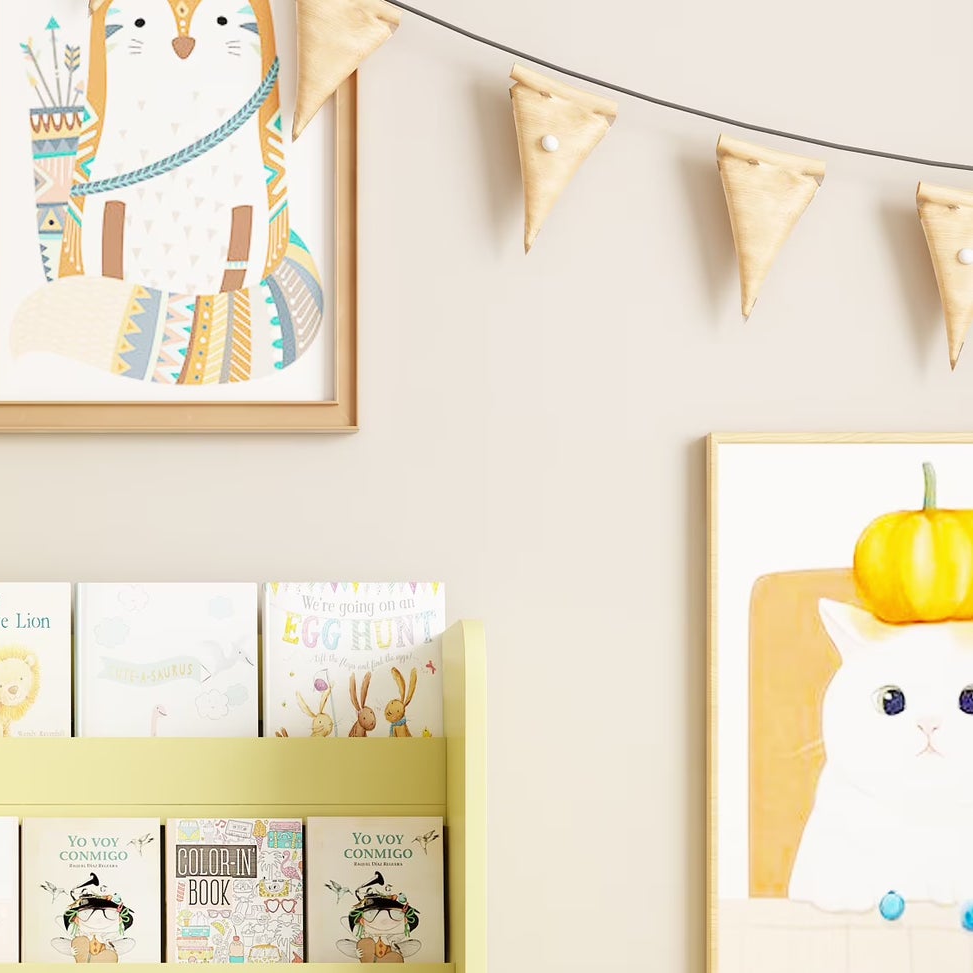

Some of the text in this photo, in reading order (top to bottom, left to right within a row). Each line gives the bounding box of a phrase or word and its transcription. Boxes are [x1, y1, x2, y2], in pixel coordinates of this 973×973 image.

[302, 594, 415, 617] We're going on an
[16, 612, 51, 629] Lion
[282, 609, 437, 652] EGG HUNT
[59, 850, 128, 861] CONMIGO
[343, 848, 413, 859] CONMIGO
[188, 879, 231, 906] BOOK
